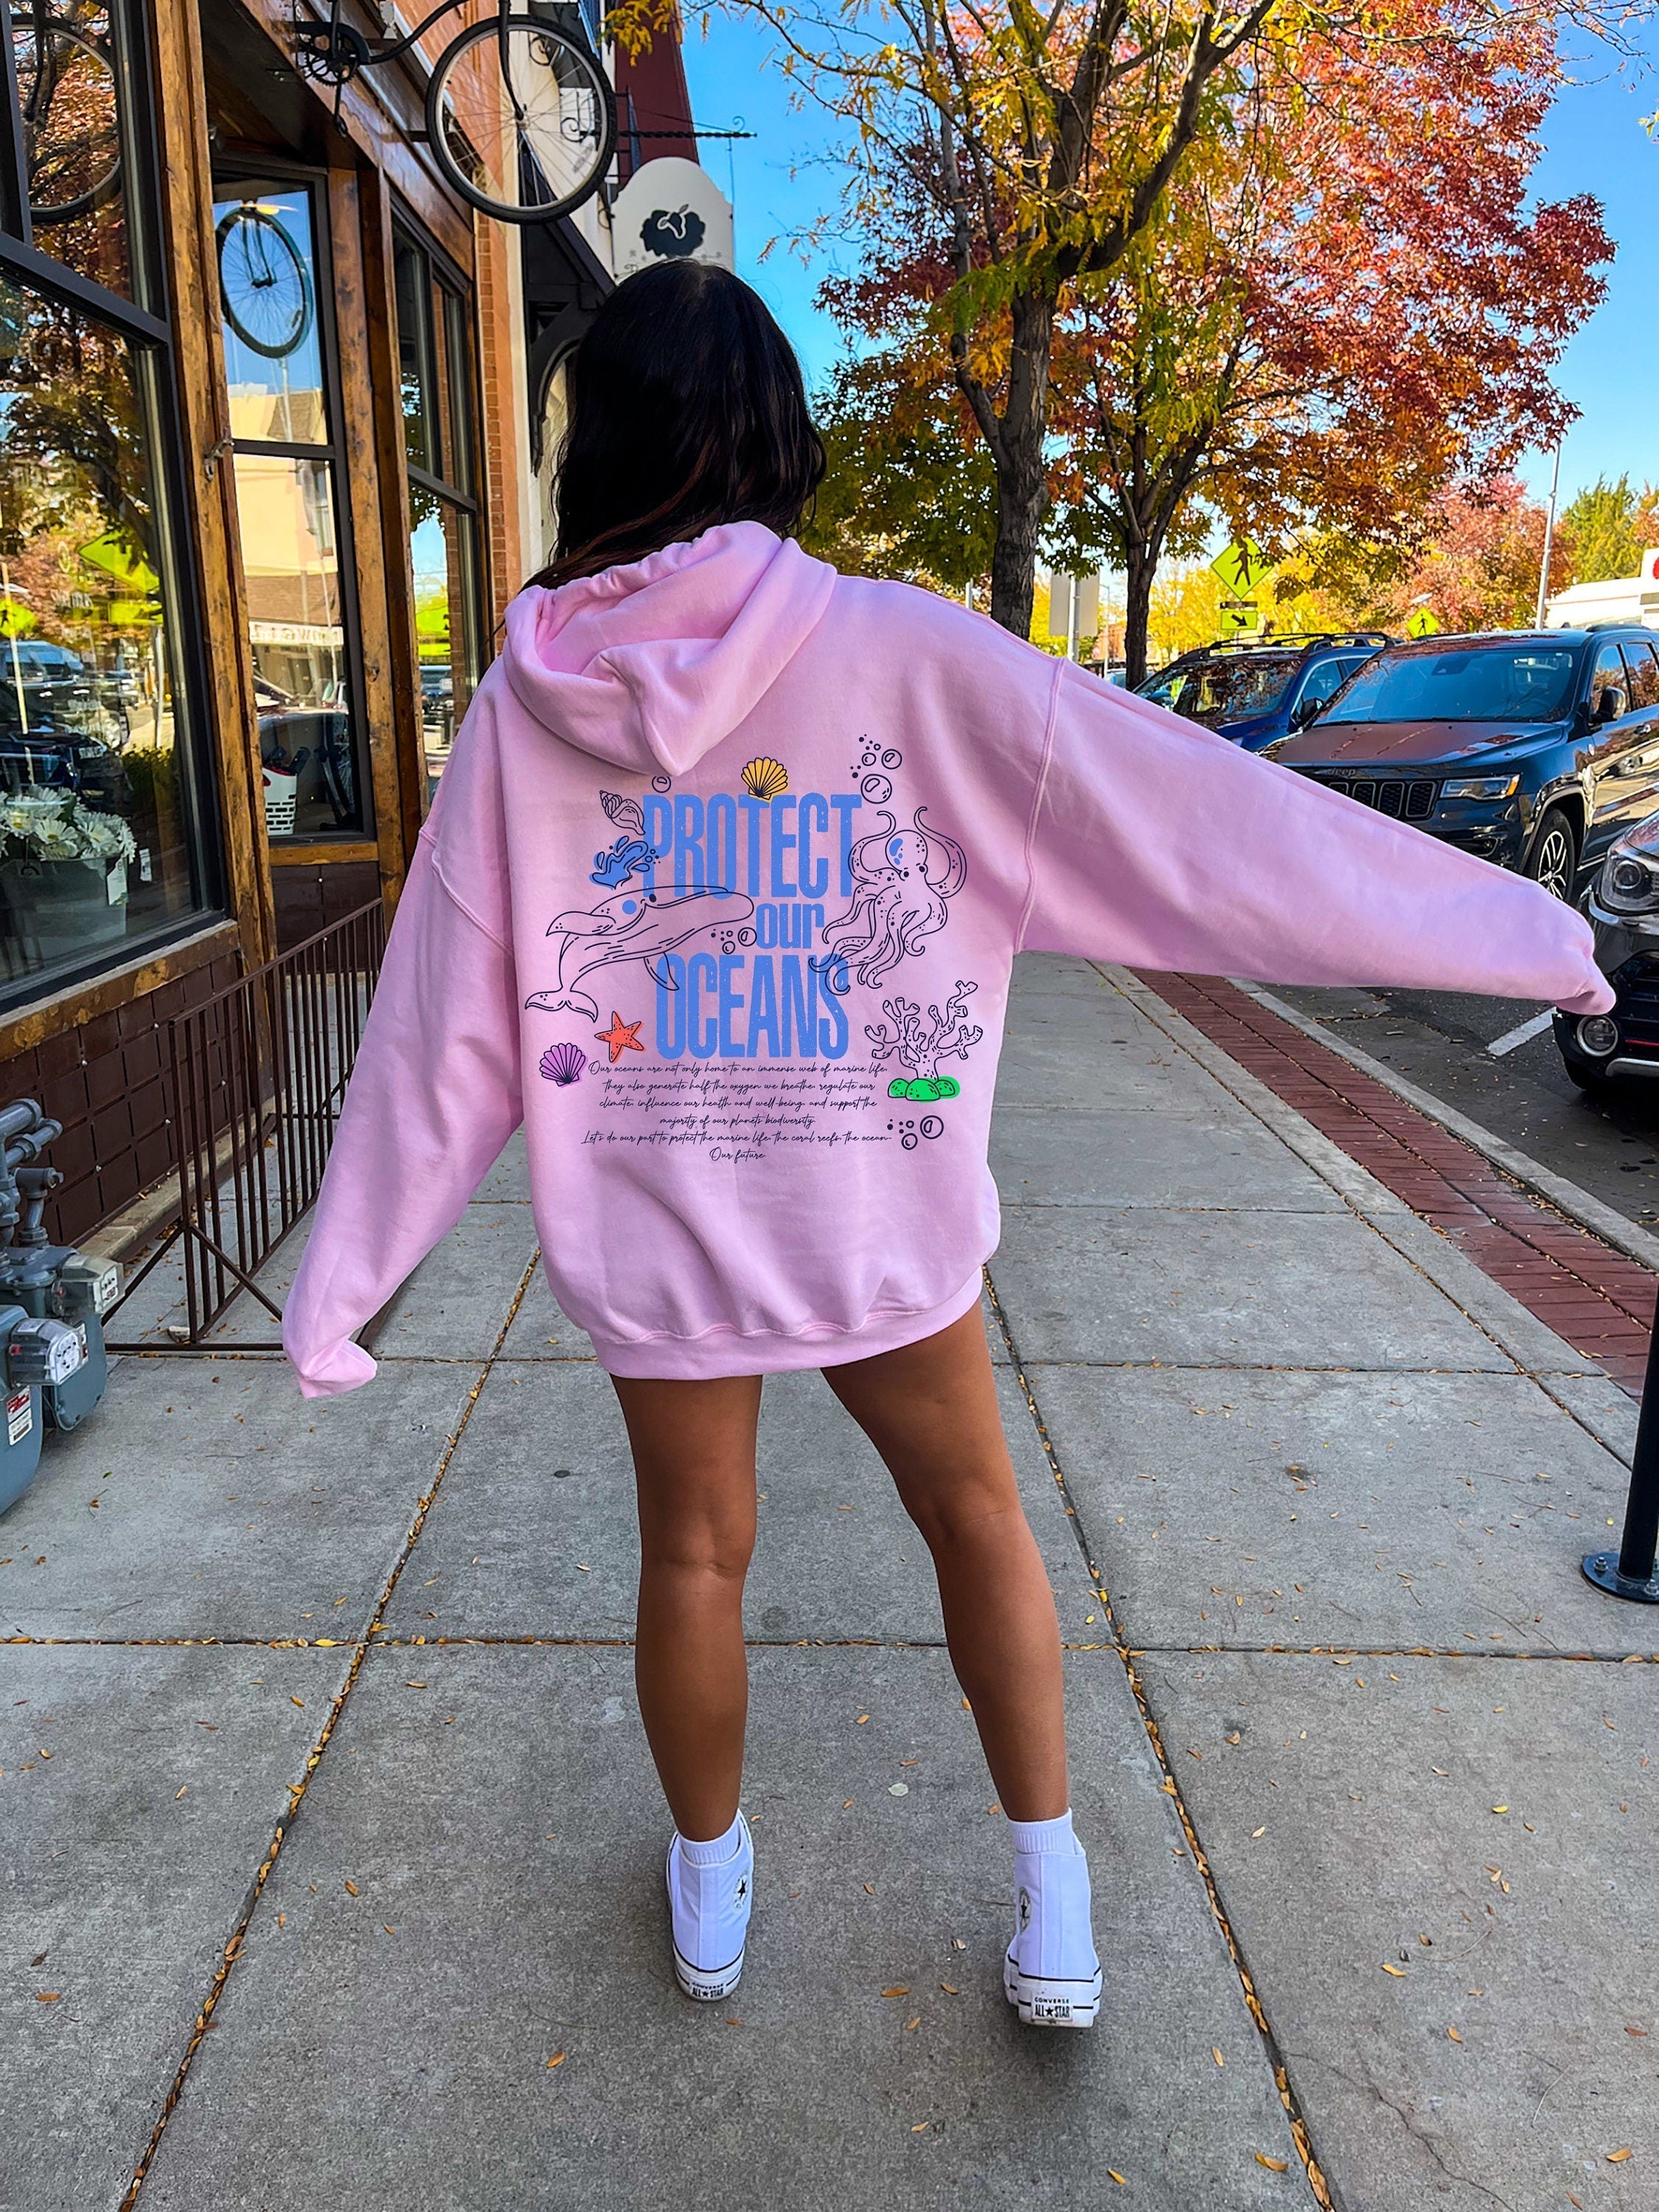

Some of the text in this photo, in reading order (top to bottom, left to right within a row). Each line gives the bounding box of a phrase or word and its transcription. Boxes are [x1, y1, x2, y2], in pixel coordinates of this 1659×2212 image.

[1327, 767, 1357, 777] Jeep
[643, 792, 862, 899] PROTECT
[654, 952, 849, 1060] OCEANS
[588, 1060, 611, 1075] Our
[664, 1061, 684, 1076] not
[682, 1062, 701, 1078] only
[704, 1061, 727, 1073] home
[728, 1061, 741, 1076] to
[758, 1065, 796, 1073] immense
[799, 1062, 818, 1073] web
[820, 1062, 831, 1077] of
[833, 1065, 865, 1073] marine
[602, 1079, 625, 1095] they
[627, 1079, 646, 1091] also
[648, 1079, 689, 1095] generate
[689, 1079, 711, 1095] half
[710, 1079, 727, 1093] the
[730, 1084, 762, 1095] oxygen
[819, 1079, 858, 1095] regulate
[637, 1096, 682, 1112] influence
[702, 1096, 732, 1110] health
[734, 1096, 753, 1107] and
[809, 1096, 827, 1109] and
[830, 1096, 861, 1111] support
[860, 1096, 877, 1110] the
[659, 1113, 697, 1130] majority
[699, 1115, 711, 1129] of
[607, 1131, 617, 1142] do
[636, 1131, 658, 1145] part
[656, 1130, 668, 1145] to
[669, 1131, 700, 1146] protect
[699, 1130, 714, 1145] the
[717, 1134, 751, 1142] marine
[772, 1130, 790, 1145] the
[791, 1131, 815, 1142] coral
[842, 1130, 860, 1145] the
[709, 1146, 733, 1161] Our
[1034, 2004, 1070, 2018] ALL STAR
